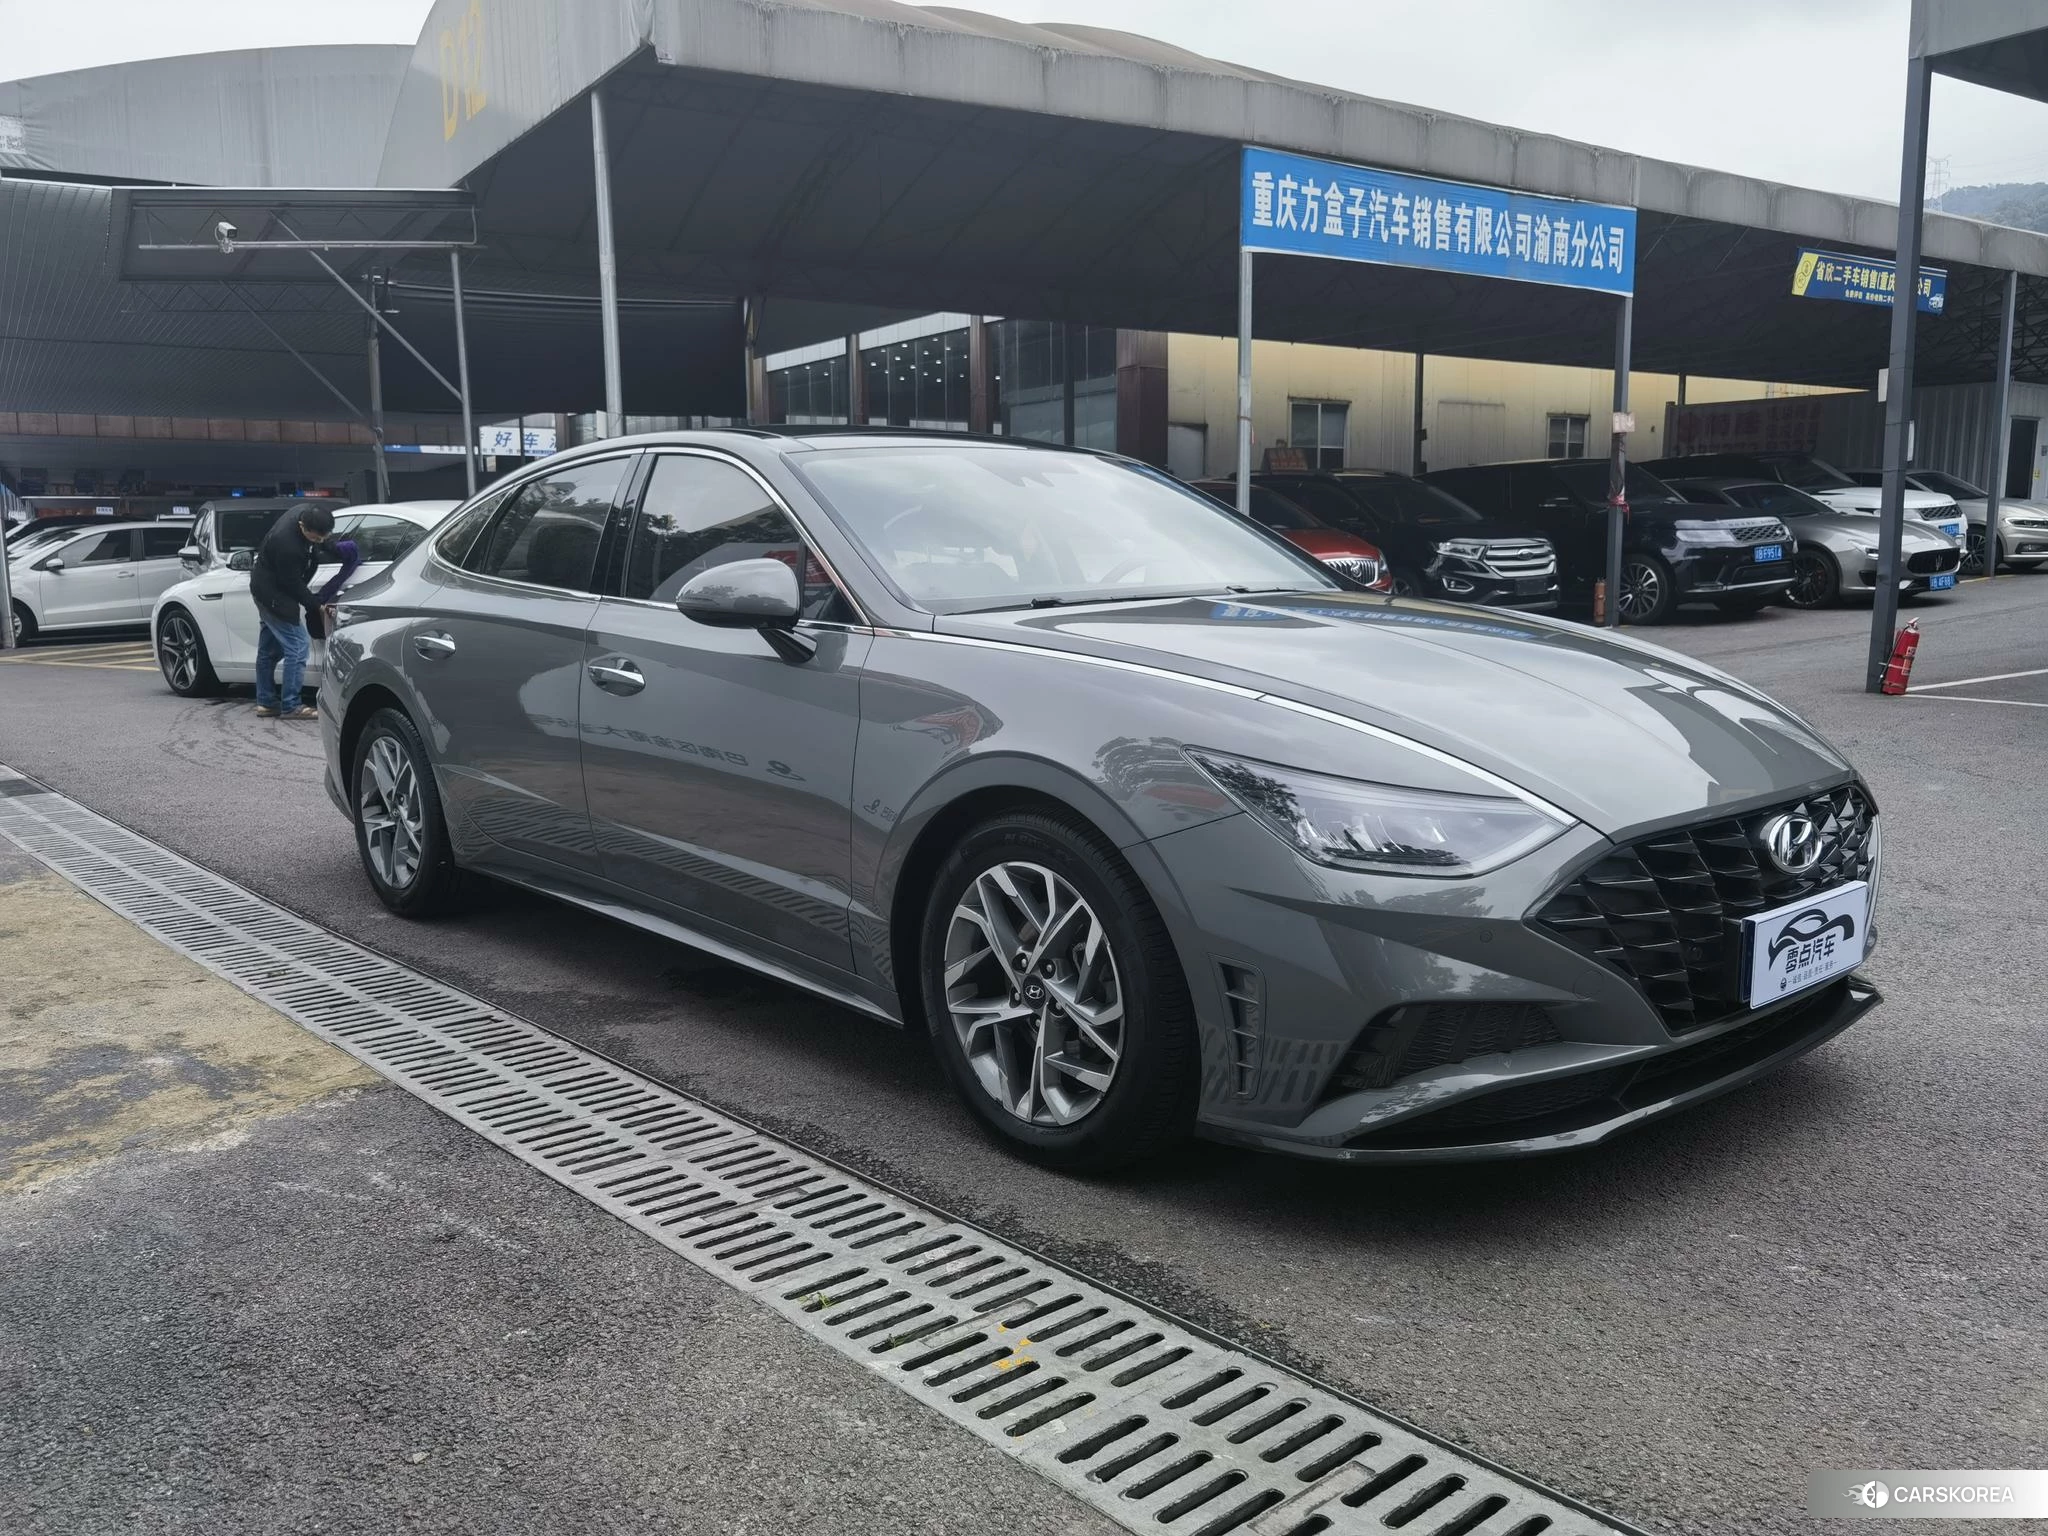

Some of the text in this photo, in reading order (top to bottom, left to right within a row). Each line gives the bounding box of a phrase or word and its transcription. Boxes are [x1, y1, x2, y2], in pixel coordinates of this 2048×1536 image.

[1252, 171, 1625, 275] 重庆方盒子汽车销售有限公司渝南分公司
[1785, 933, 1837, 974] 零点汽车
